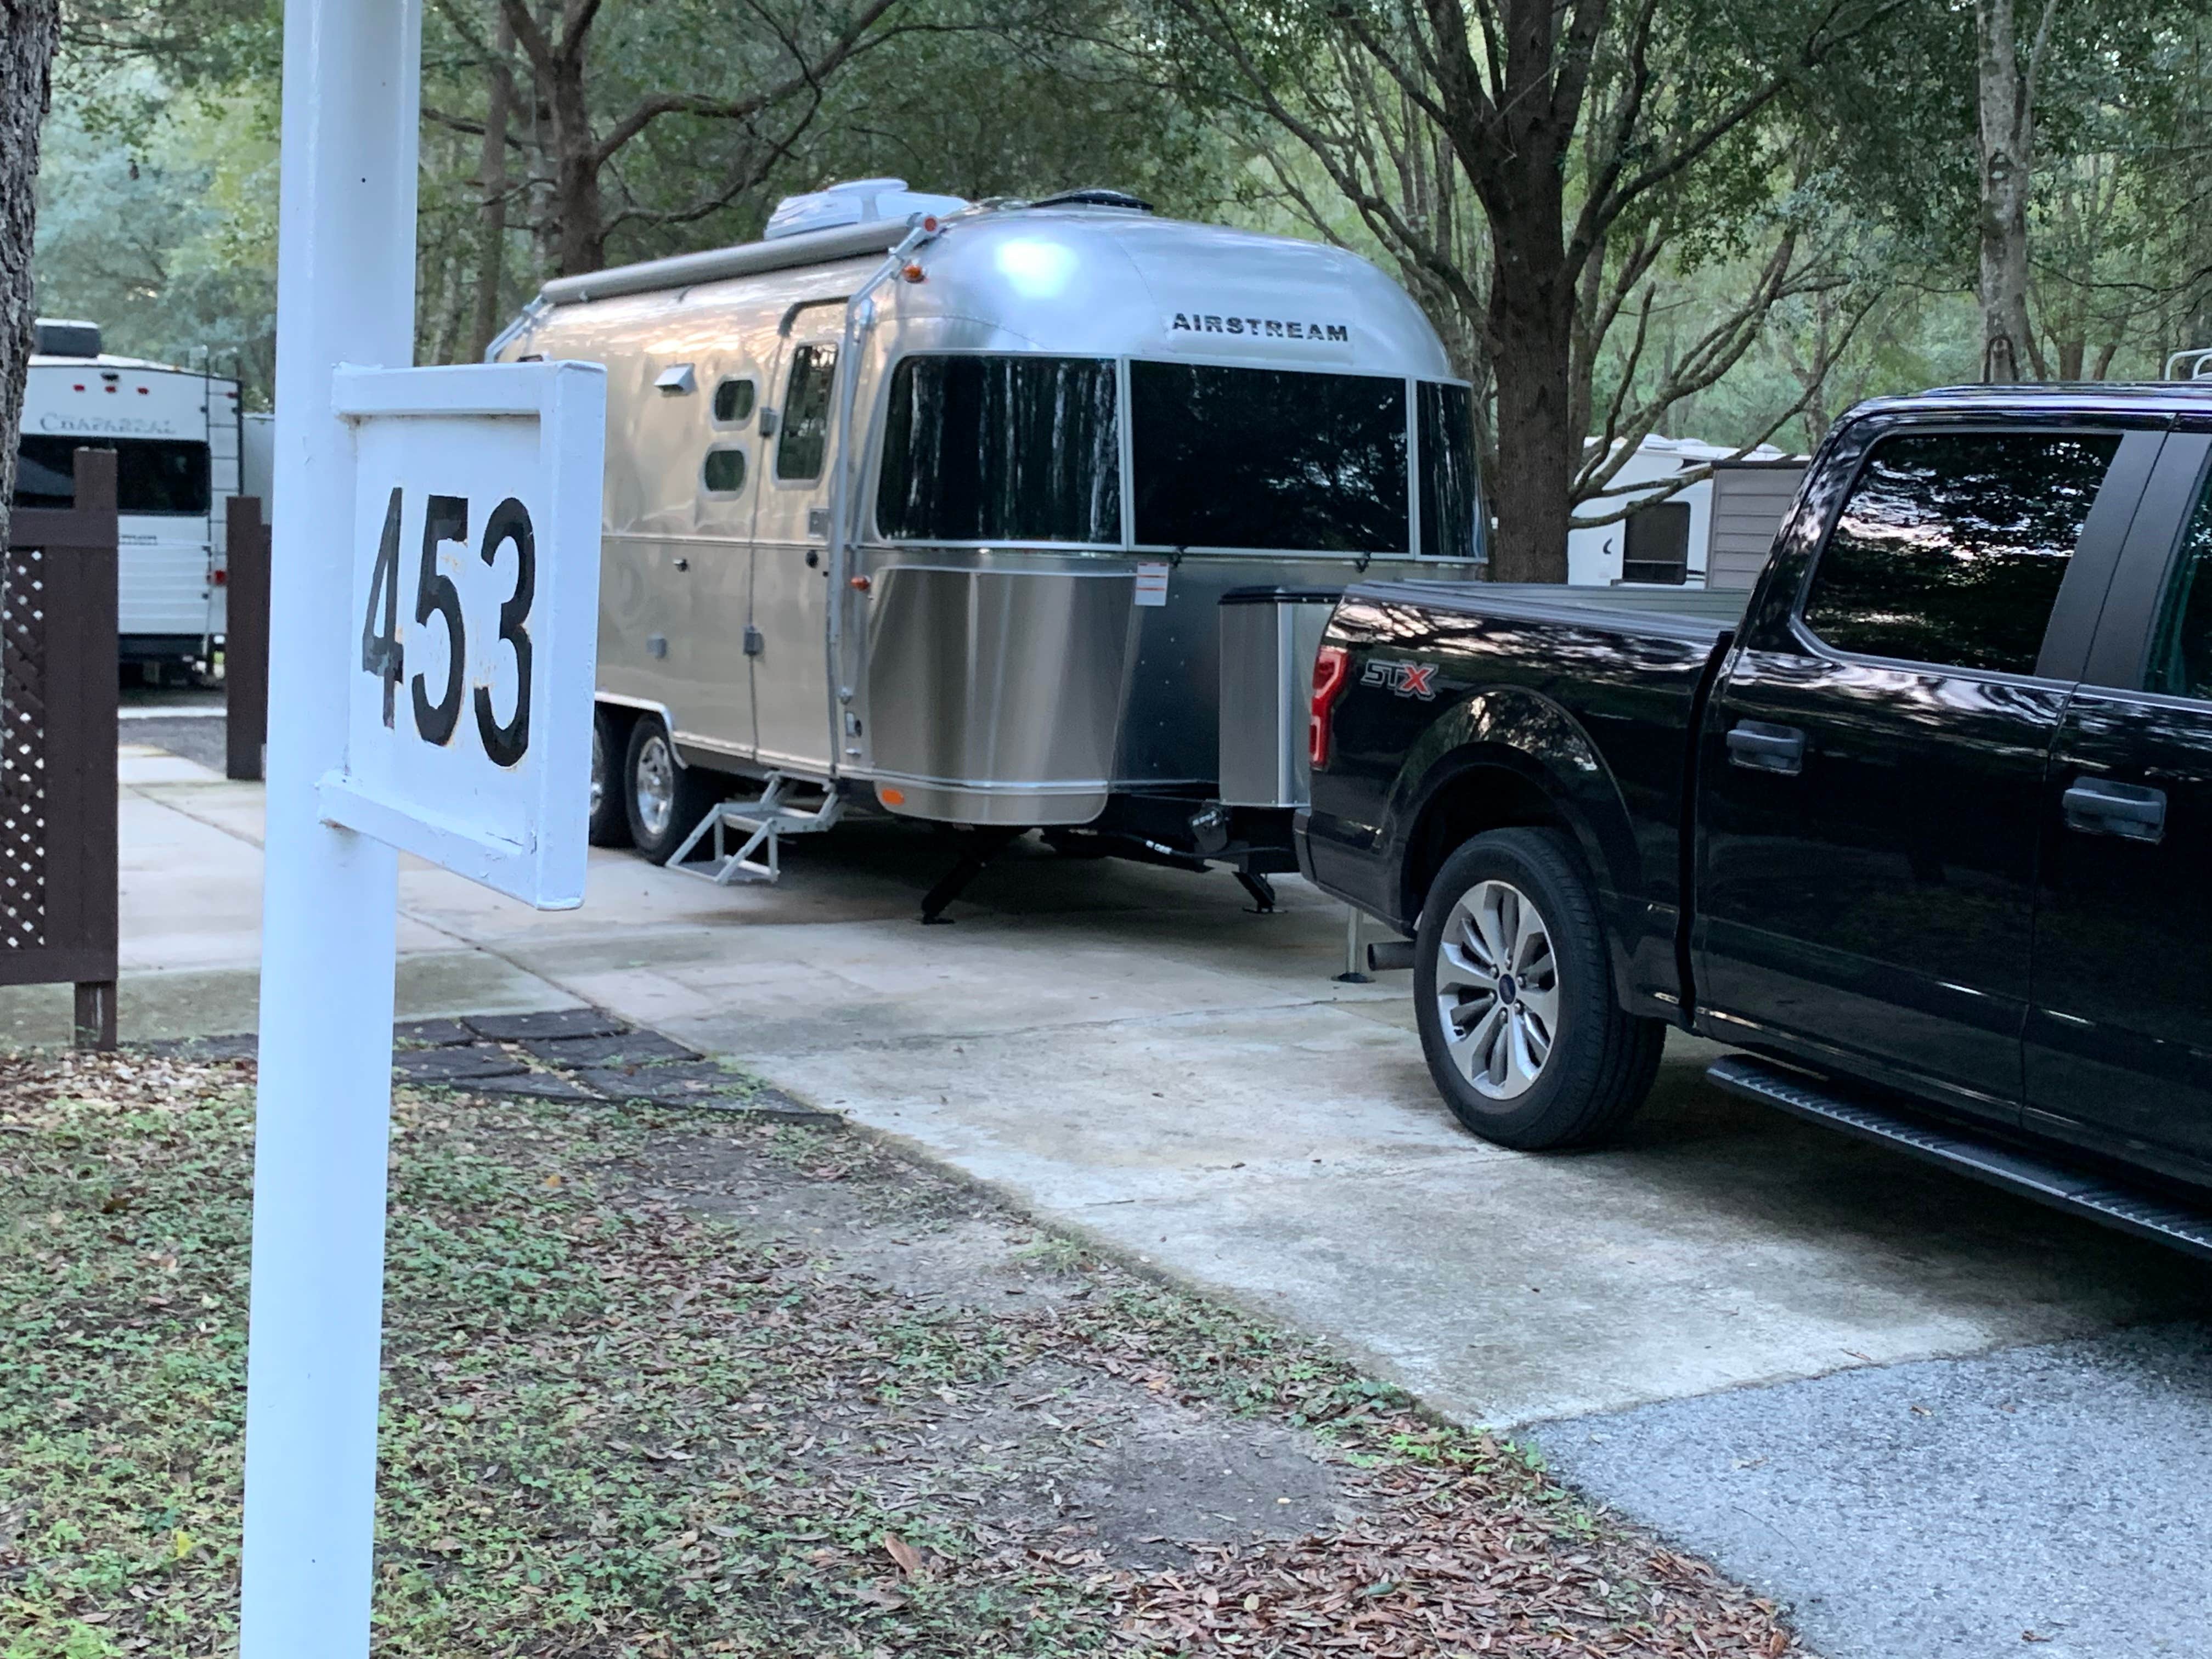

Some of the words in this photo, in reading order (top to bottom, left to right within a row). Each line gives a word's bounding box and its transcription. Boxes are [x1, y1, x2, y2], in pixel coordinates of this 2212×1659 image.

[1172, 313, 1348, 342] AIRSTREAM
[362, 487, 537, 767] 453
[1360, 659, 1440, 702] STX
